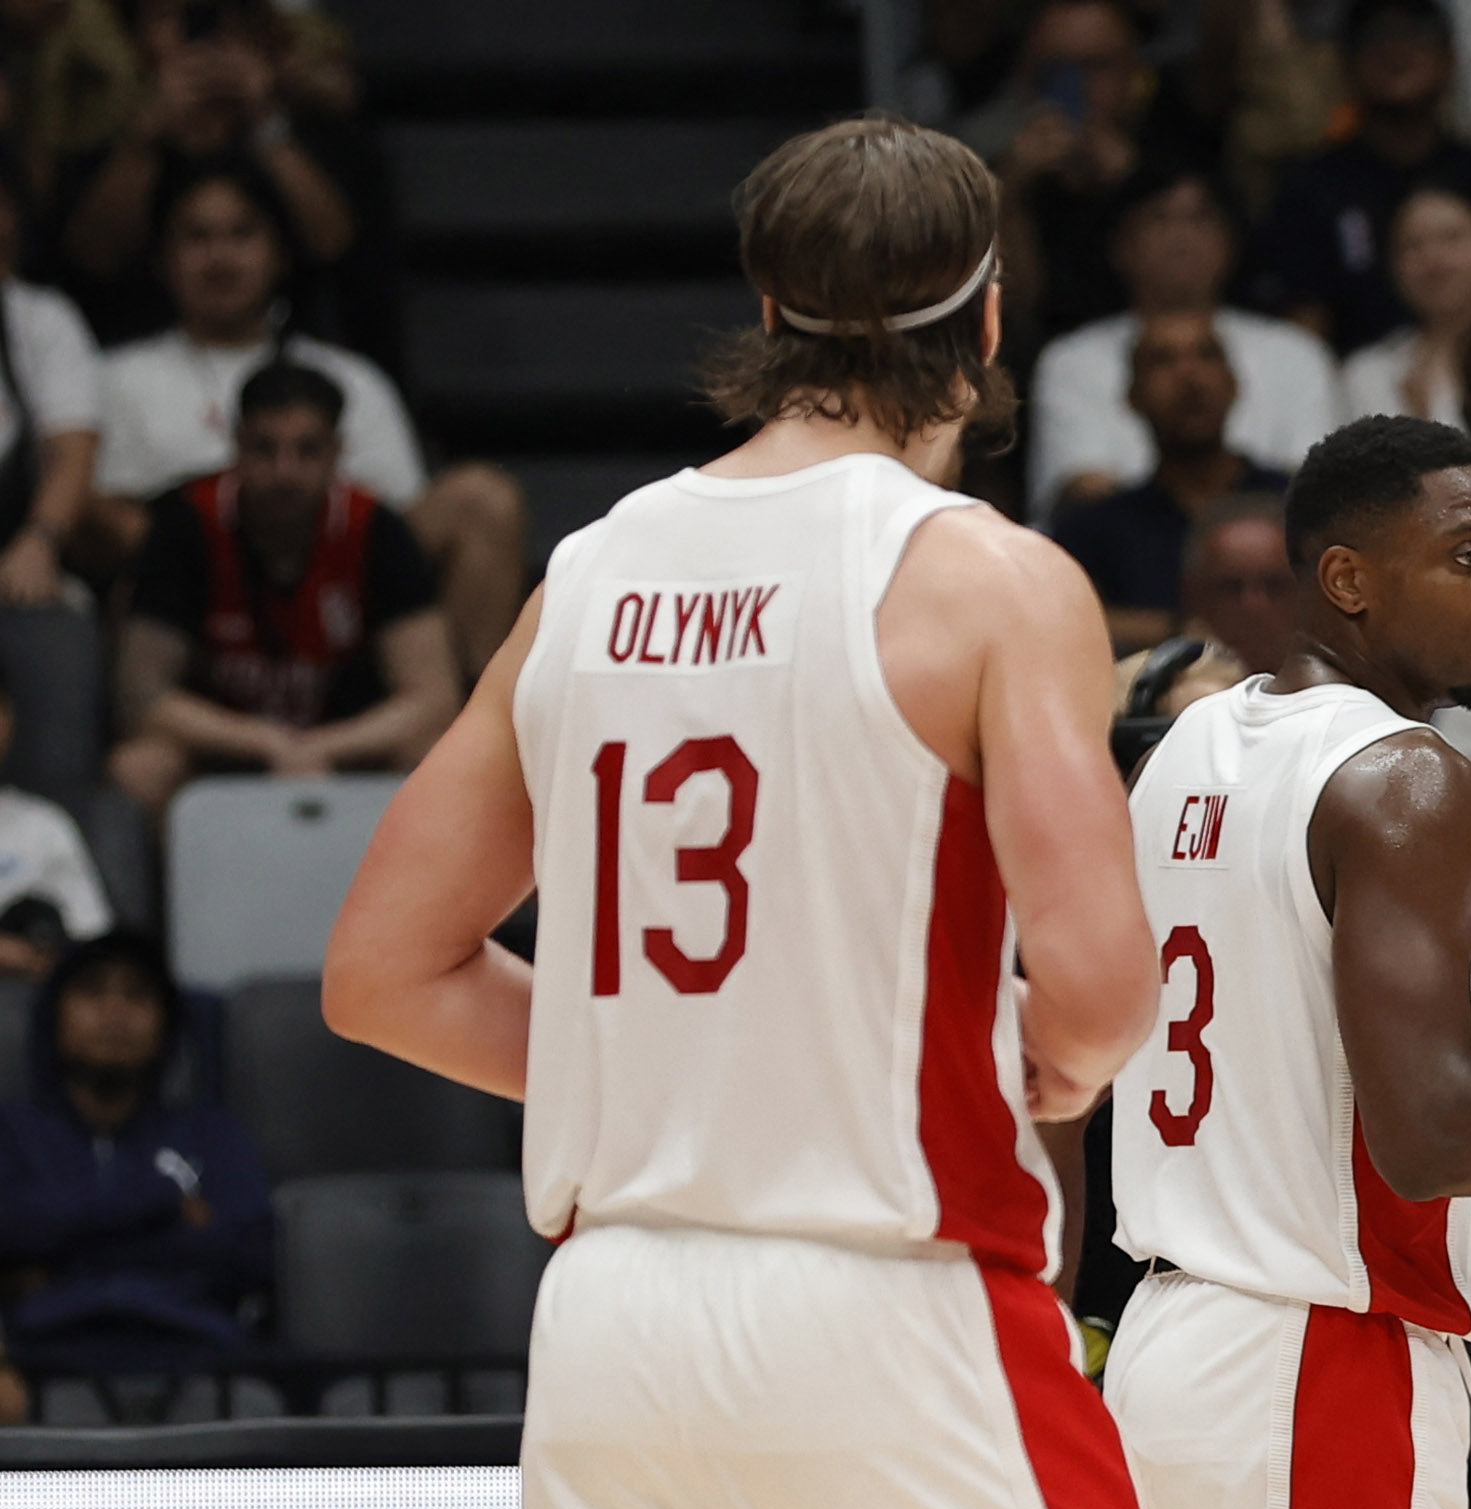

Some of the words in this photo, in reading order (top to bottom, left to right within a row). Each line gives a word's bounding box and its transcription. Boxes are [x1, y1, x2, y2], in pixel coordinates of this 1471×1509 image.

[607, 584, 780, 665] OLYNYK
[592, 734, 760, 996] 13
[1149, 925, 1215, 1147] 3
